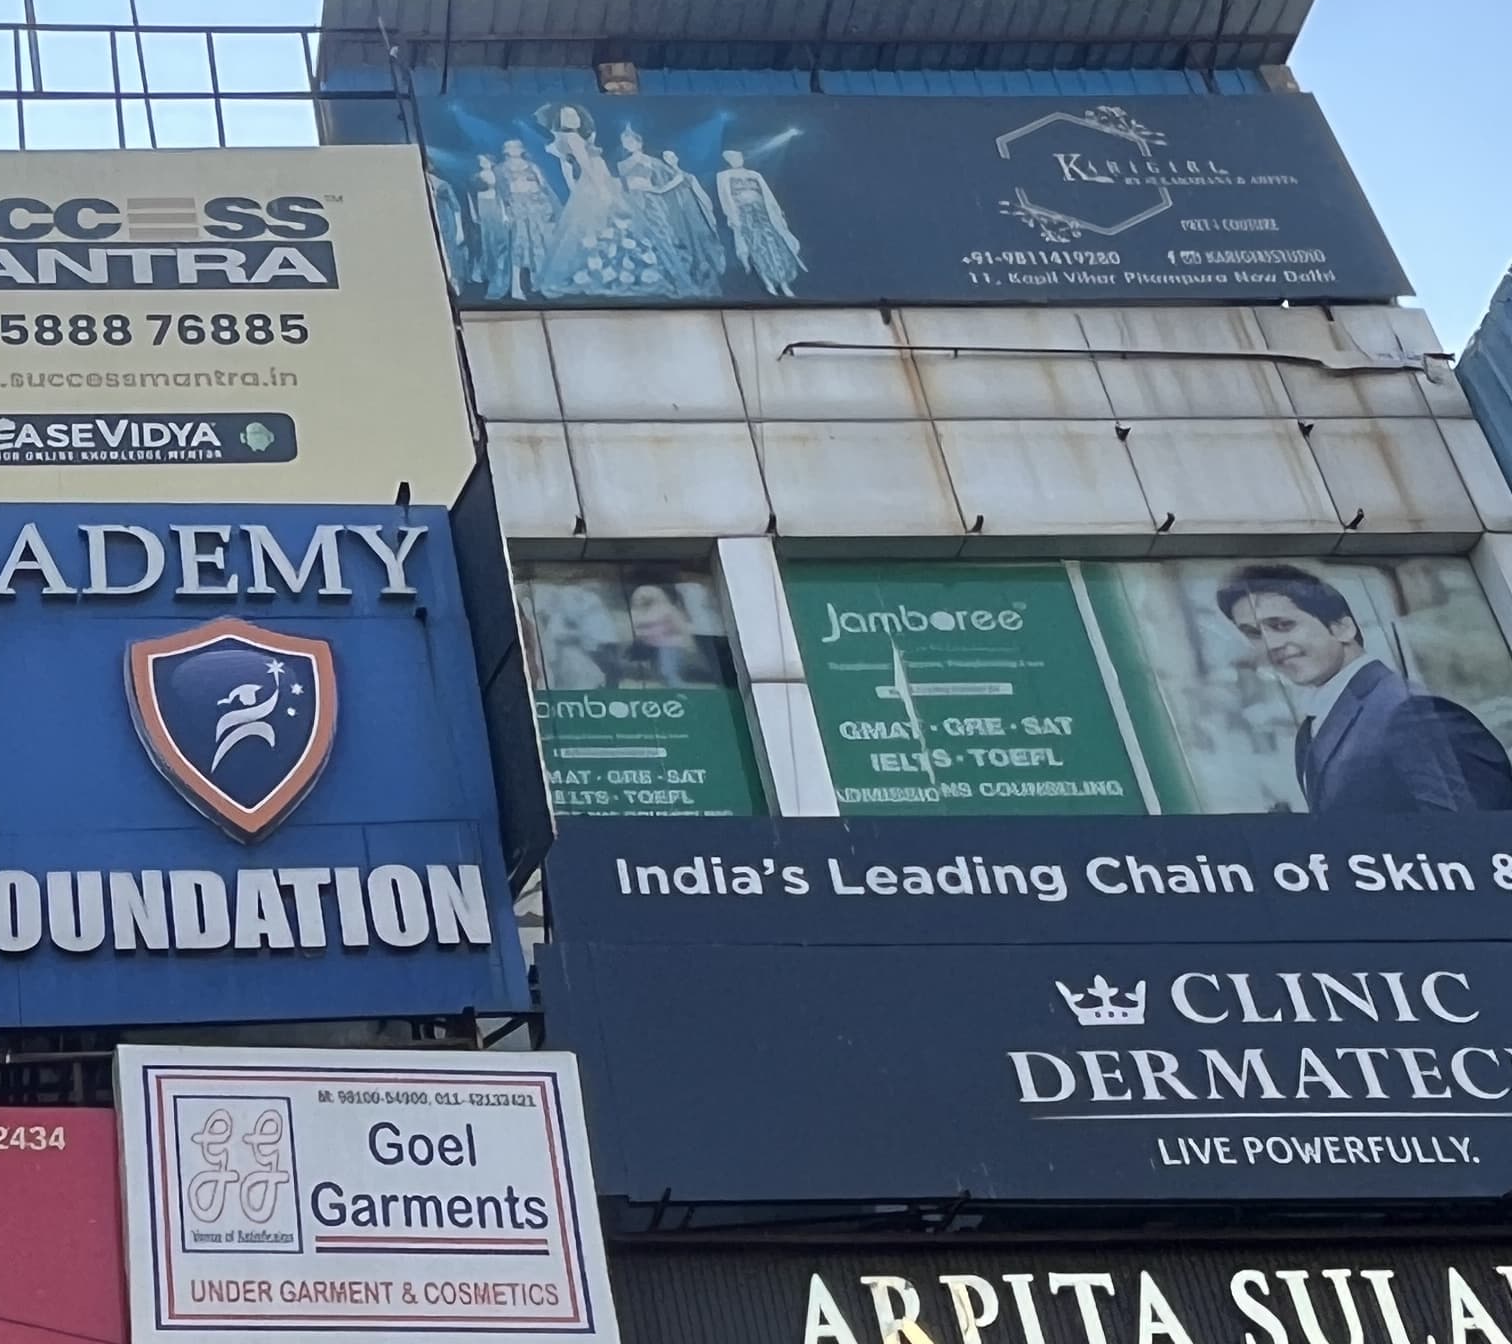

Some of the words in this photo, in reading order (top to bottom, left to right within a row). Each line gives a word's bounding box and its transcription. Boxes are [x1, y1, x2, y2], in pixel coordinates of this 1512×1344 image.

[146, 313, 309, 346] 76885
[822, 603, 1025, 644] Jamboree
[536, 695, 688, 719] amboree
[839, 719, 922, 740] GMAT
[942, 716, 1007, 737] GRE
[1021, 715, 1073, 736] SAT
[870, 748, 953, 773] IELTS
[966, 747, 1065, 768] TOEFL
[618, 856, 810, 897] India's
[830, 856, 1069, 902] Leading
[1086, 855, 1255, 896] Chain
[1275, 855, 1331, 894] of
[1353, 852, 1476, 893] Skin
[1170, 970, 1481, 1025] CLINIC
[1008, 1046, 1512, 1104] DERMATEC
[369, 1121, 477, 1168] Goel
[1158, 1137, 1237, 1166] LIVE
[1243, 1136, 1480, 1166] POWERFULLY.
[311, 1181, 549, 1230] Garments
[191, 1279, 273, 1304] UNDER
[280, 1280, 392, 1306] GARMENT
[402, 1282, 419, 1305] &
[424, 1282, 560, 1307] COSMETICS
